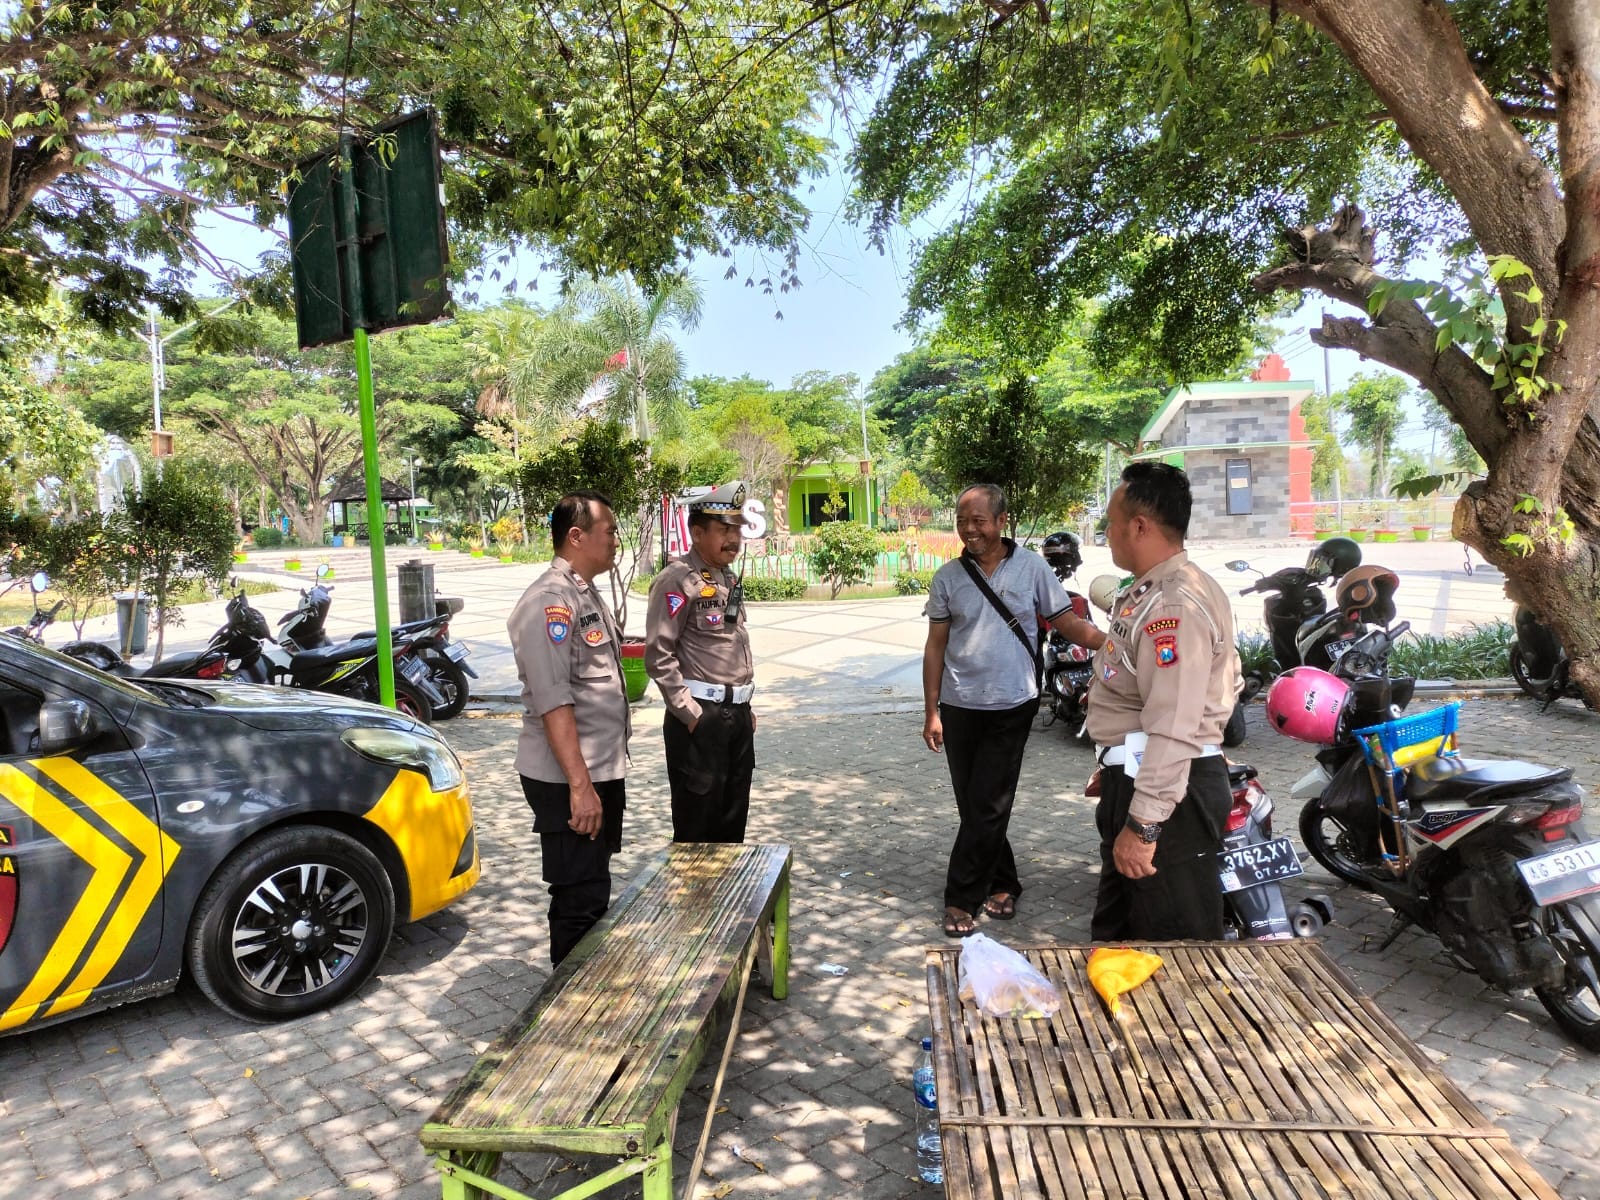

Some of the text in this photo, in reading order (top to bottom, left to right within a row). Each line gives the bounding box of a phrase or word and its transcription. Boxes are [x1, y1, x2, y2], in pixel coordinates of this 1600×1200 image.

[1223, 840, 1289, 871] 3762 XY
[1553, 849, 1596, 873] 5311
